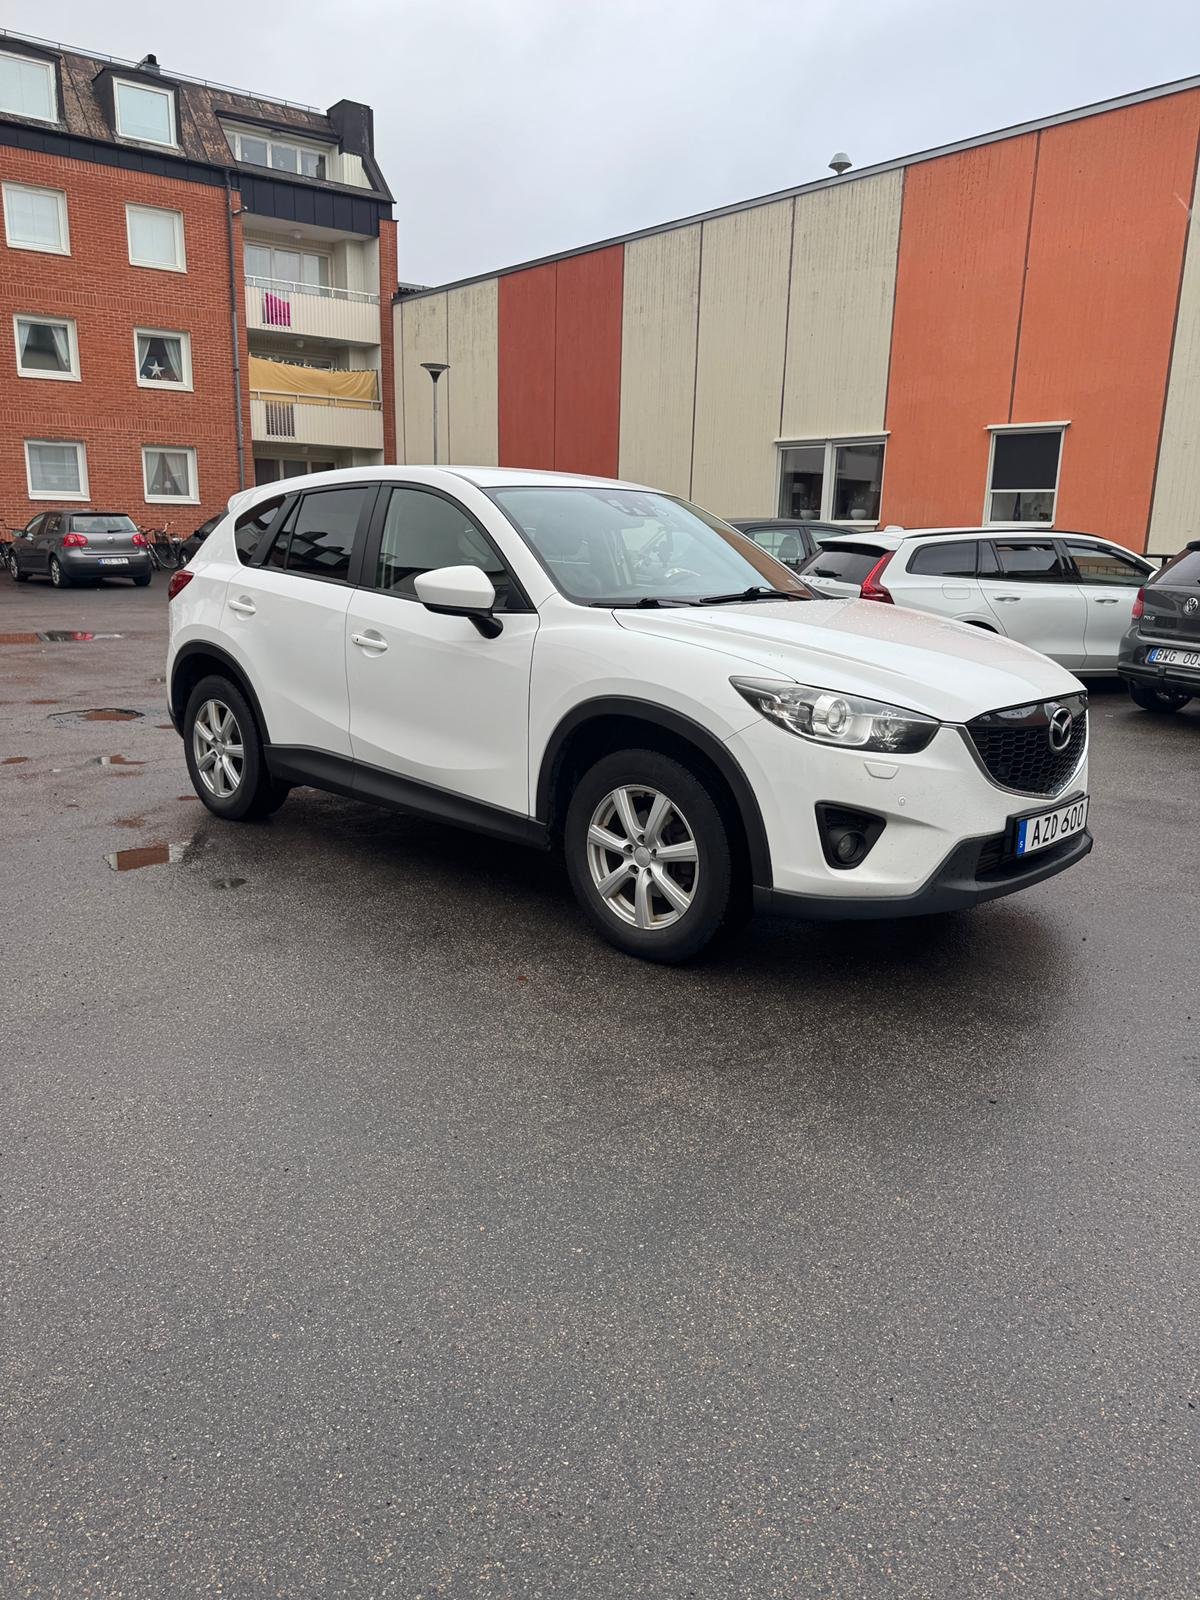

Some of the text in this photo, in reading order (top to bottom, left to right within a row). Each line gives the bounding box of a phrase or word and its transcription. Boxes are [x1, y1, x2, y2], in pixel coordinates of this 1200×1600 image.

[1156, 648, 1200, 667] BWG 00
[1031, 803, 1084, 847] AZD 600
